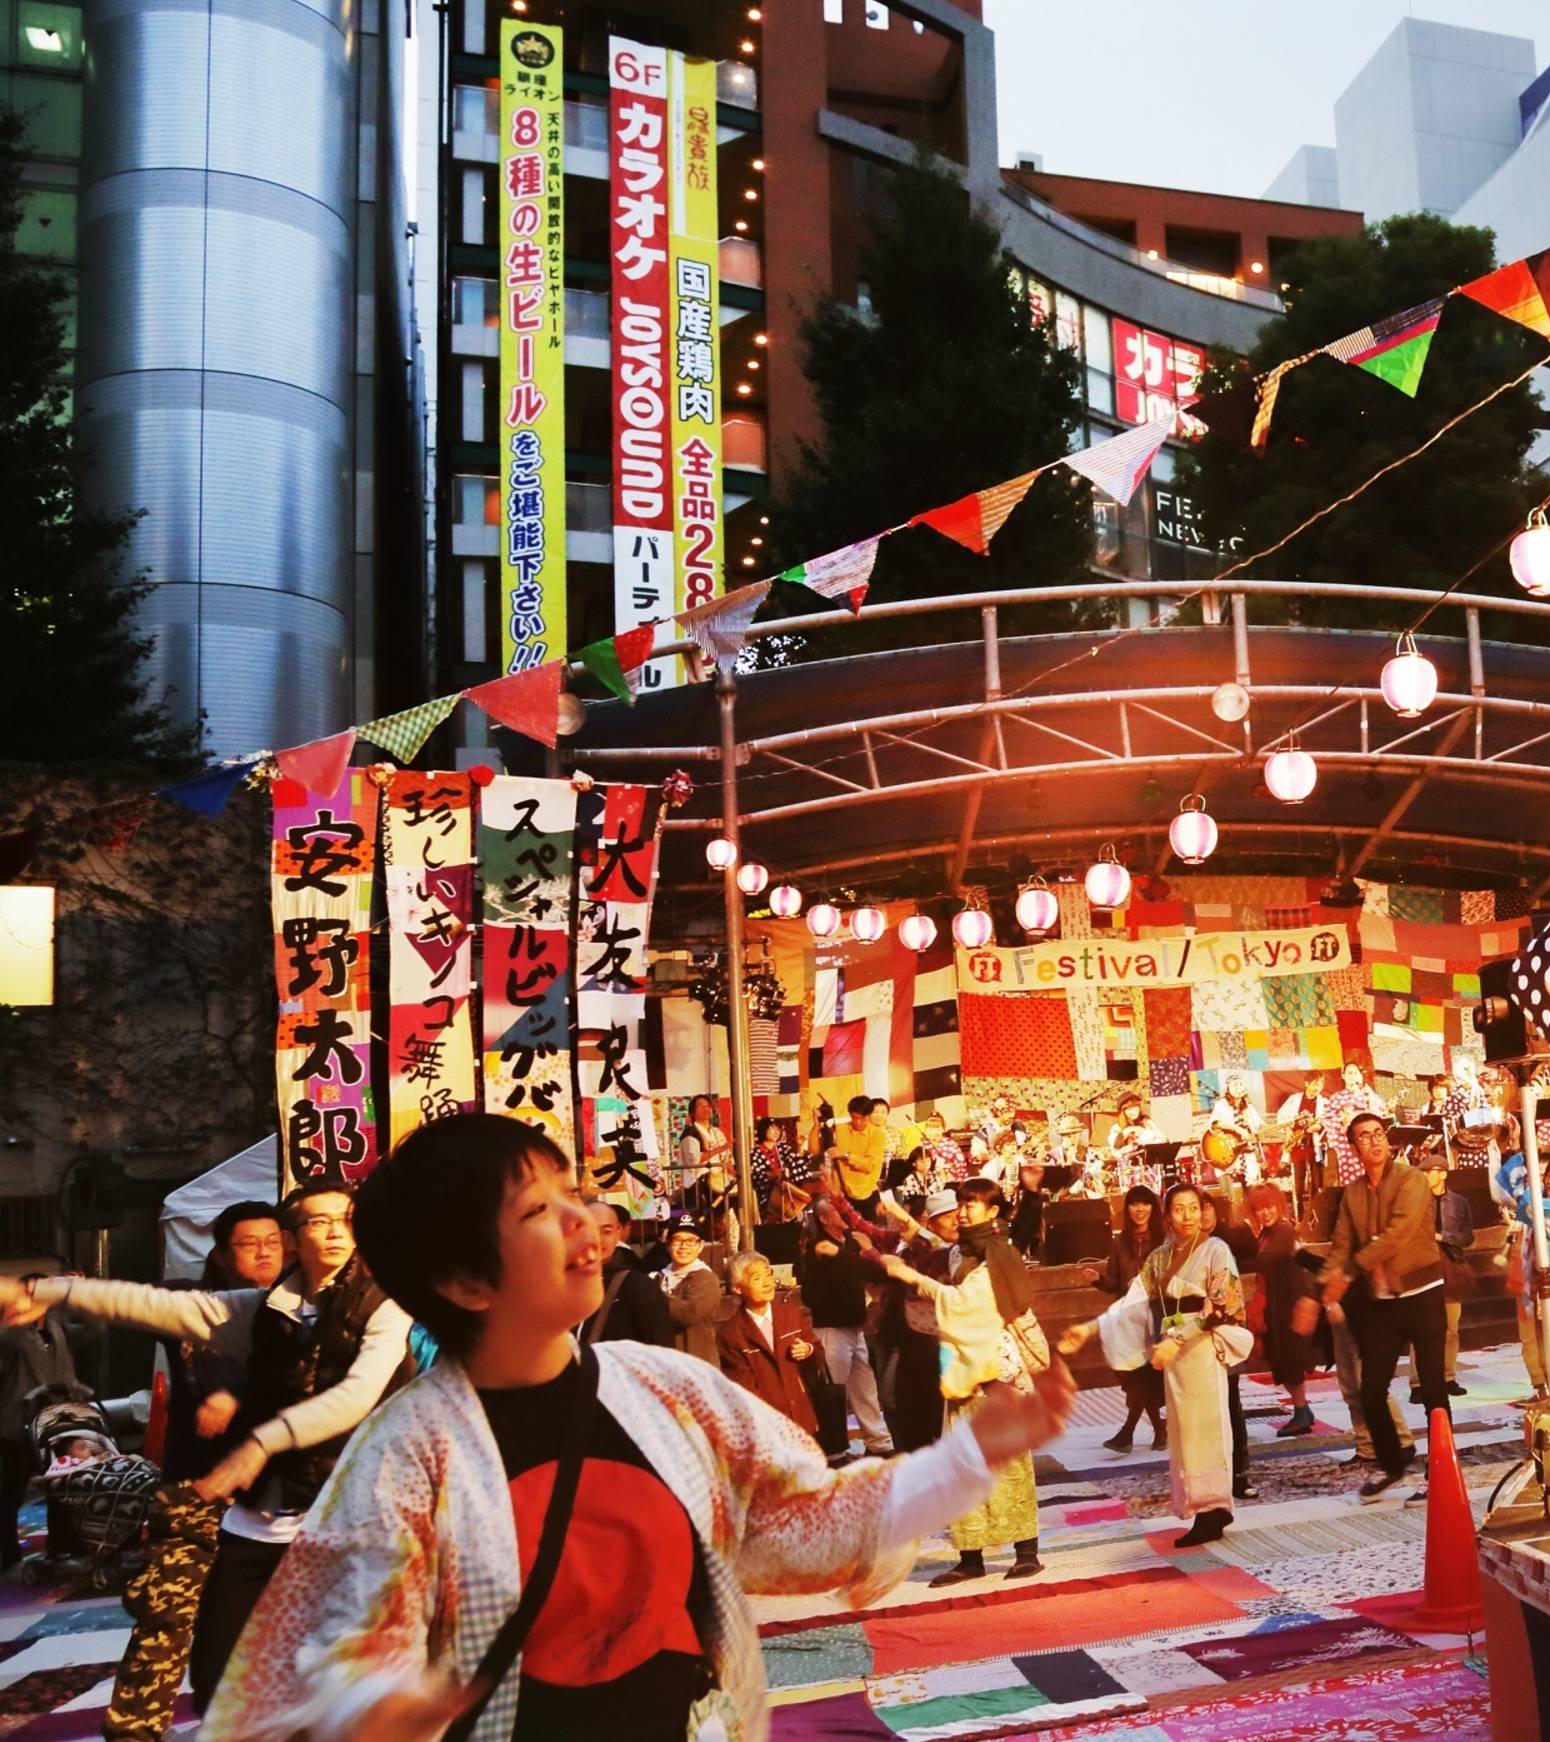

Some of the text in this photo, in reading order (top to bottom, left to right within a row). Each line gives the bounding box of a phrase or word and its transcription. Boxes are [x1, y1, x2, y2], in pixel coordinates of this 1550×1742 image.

[504, 84, 560, 102] ライオン
[614, 52, 662, 86] 6F
[615, 102, 667, 520] カラオケ JOYSOUND
[282, 810, 367, 1183] 安野太郎
[500, 798, 562, 1134] スペシャルビッグバ
